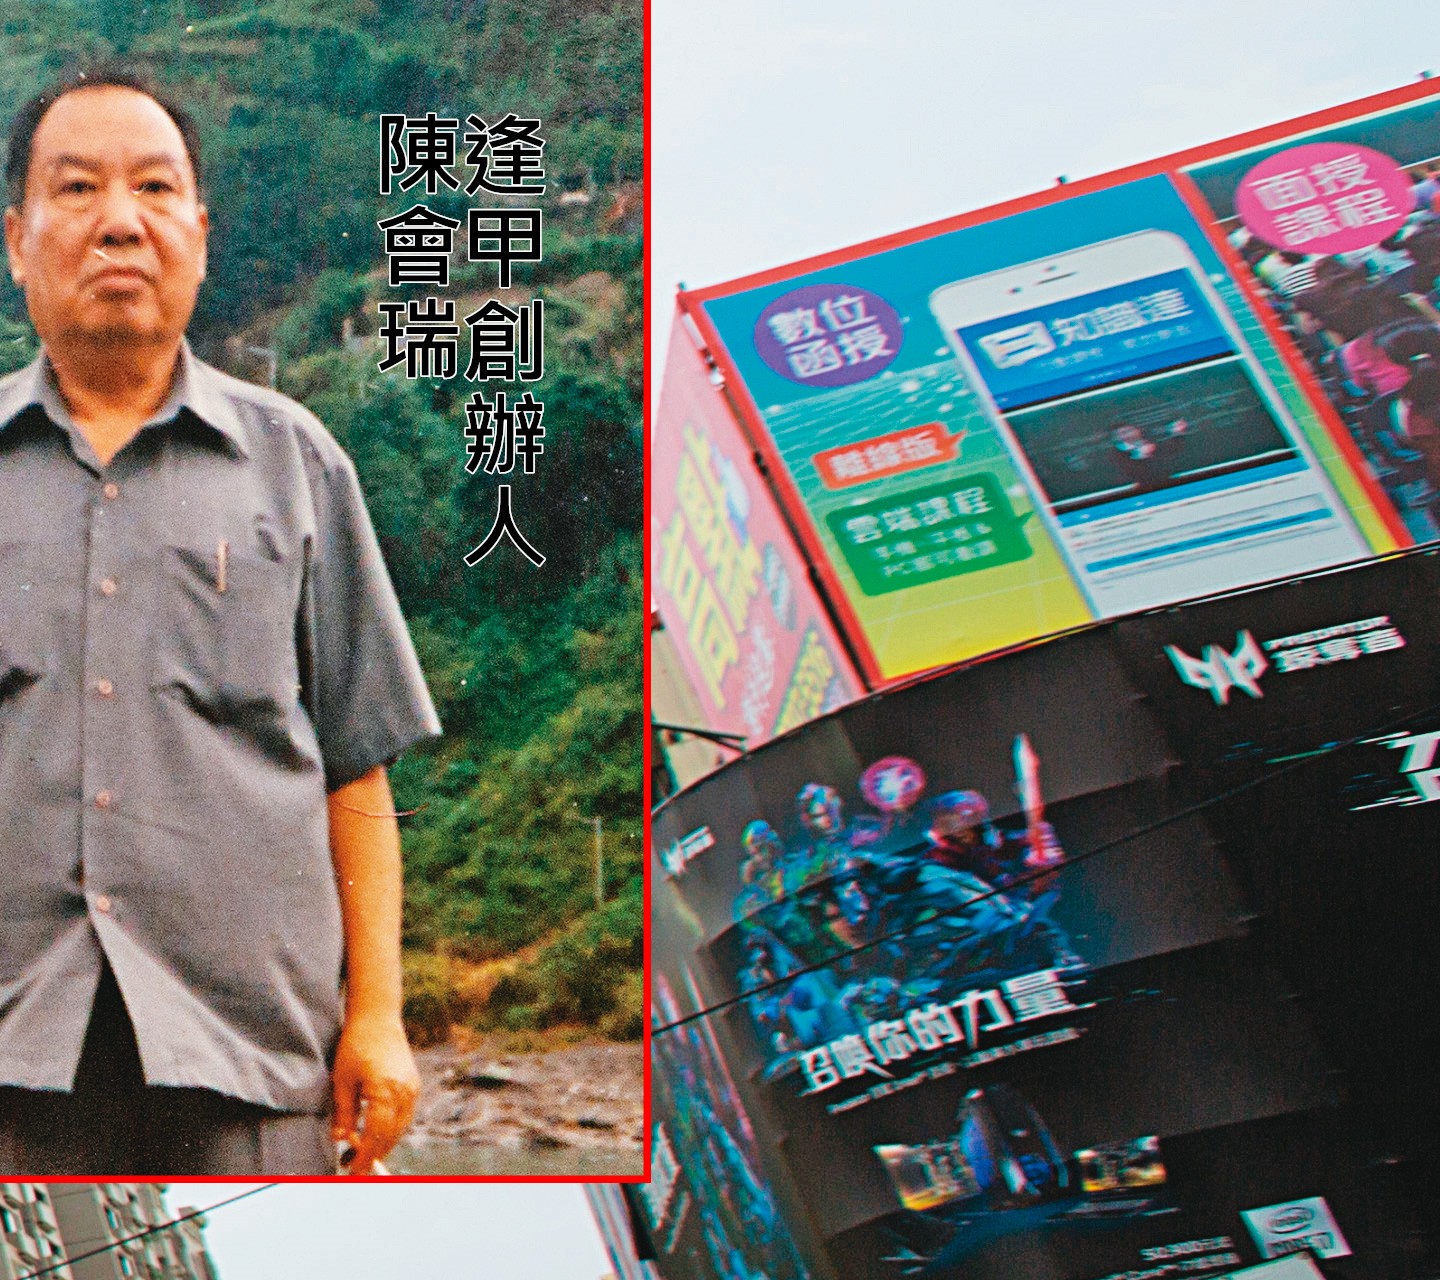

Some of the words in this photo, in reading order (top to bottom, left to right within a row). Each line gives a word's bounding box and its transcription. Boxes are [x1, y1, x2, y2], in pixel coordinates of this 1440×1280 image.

[1247, 152, 1377, 211] 面授
[1271, 187, 1402, 246] 課程
[767, 293, 879, 348] 數位
[786, 323, 895, 379] 函授
[795, 964, 1094, 1098] 召喚你的力量
